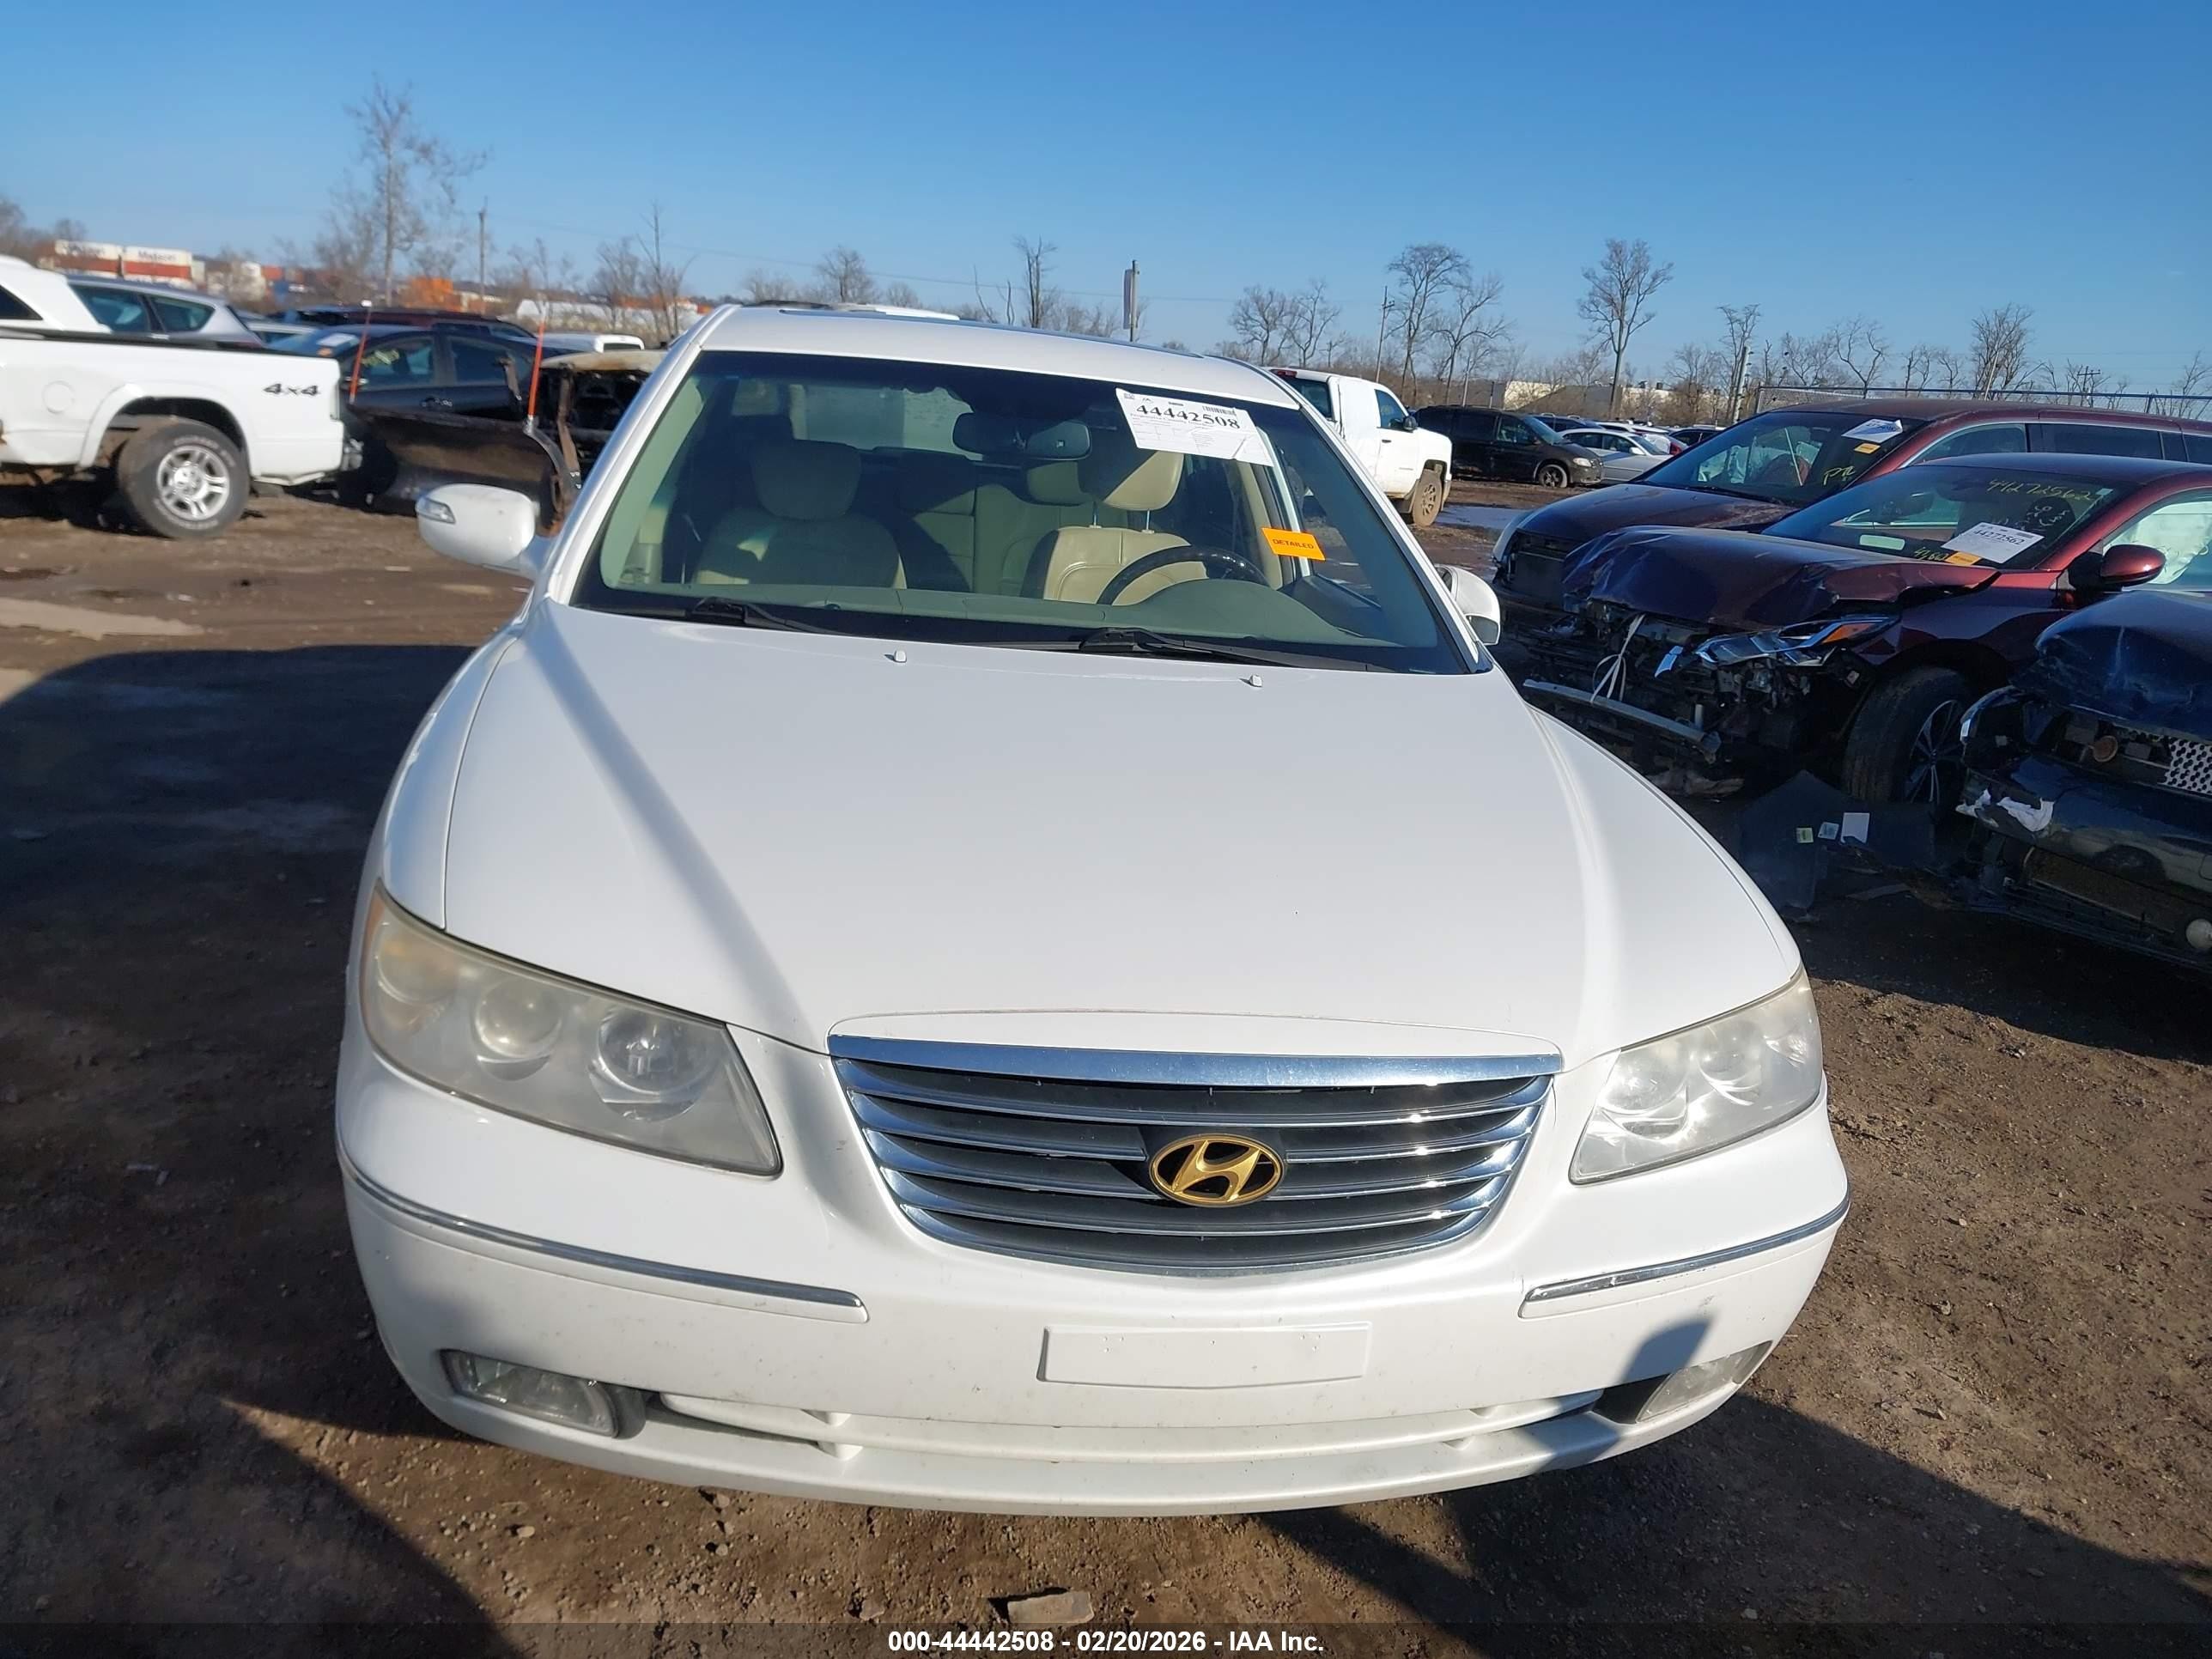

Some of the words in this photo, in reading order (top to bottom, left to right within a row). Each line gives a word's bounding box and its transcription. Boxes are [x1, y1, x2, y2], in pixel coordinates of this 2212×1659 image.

[1135, 404, 1242, 429] 44442508
[1272, 538, 1315, 550] DETAILED
[1972, 529, 2026, 546] 44272562
